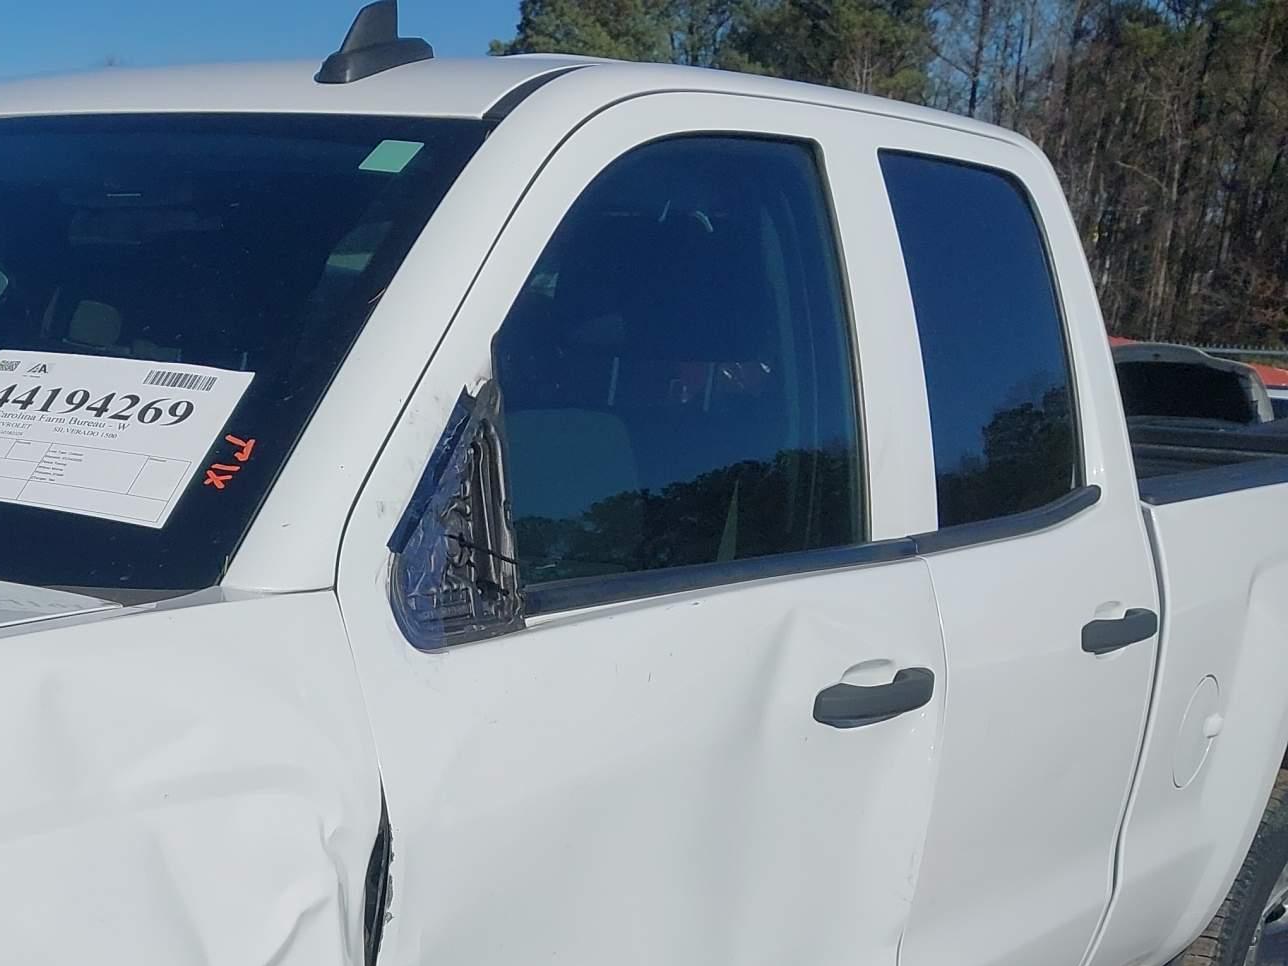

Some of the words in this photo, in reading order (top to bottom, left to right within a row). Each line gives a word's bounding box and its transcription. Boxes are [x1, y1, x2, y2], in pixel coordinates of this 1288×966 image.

[39, 414, 66, 424] Farm
[68, 417, 106, 428] Bureau
[118, 422, 130, 430] W
[54, 427, 100, 437] SILVERADO
